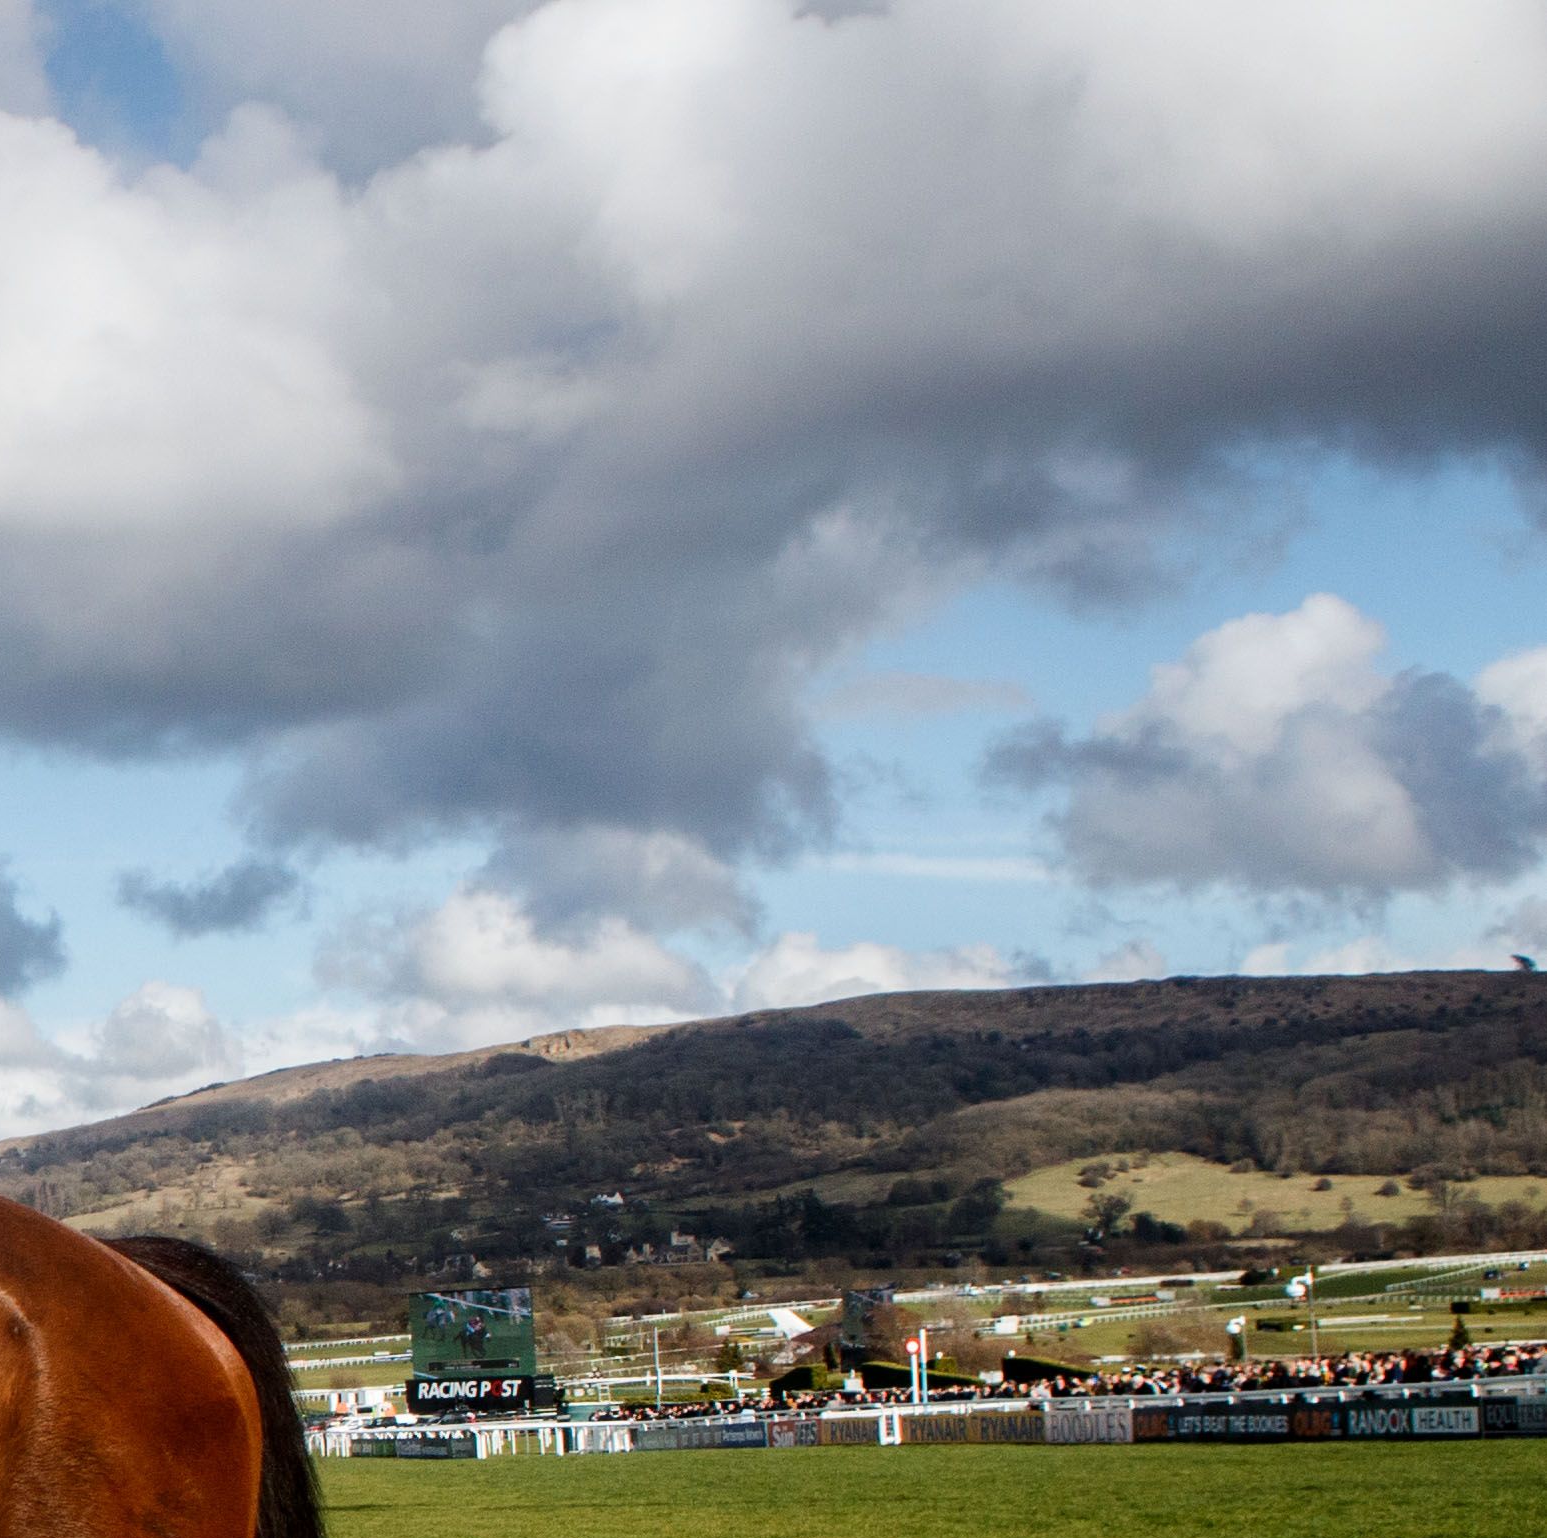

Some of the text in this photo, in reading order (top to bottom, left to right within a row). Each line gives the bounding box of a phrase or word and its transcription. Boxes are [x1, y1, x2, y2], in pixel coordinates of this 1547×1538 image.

[418, 1379, 522, 1399] RACING POST
[910, 1416, 967, 1442] RYANAIR
[981, 1412, 1046, 1442] RYANAIR
[1050, 1411, 1129, 1442] BOODLES
[1230, 1415, 1246, 1433] THE
[1349, 1408, 1410, 1435] RANDOX
[1417, 1408, 1472, 1431] HEALTH
